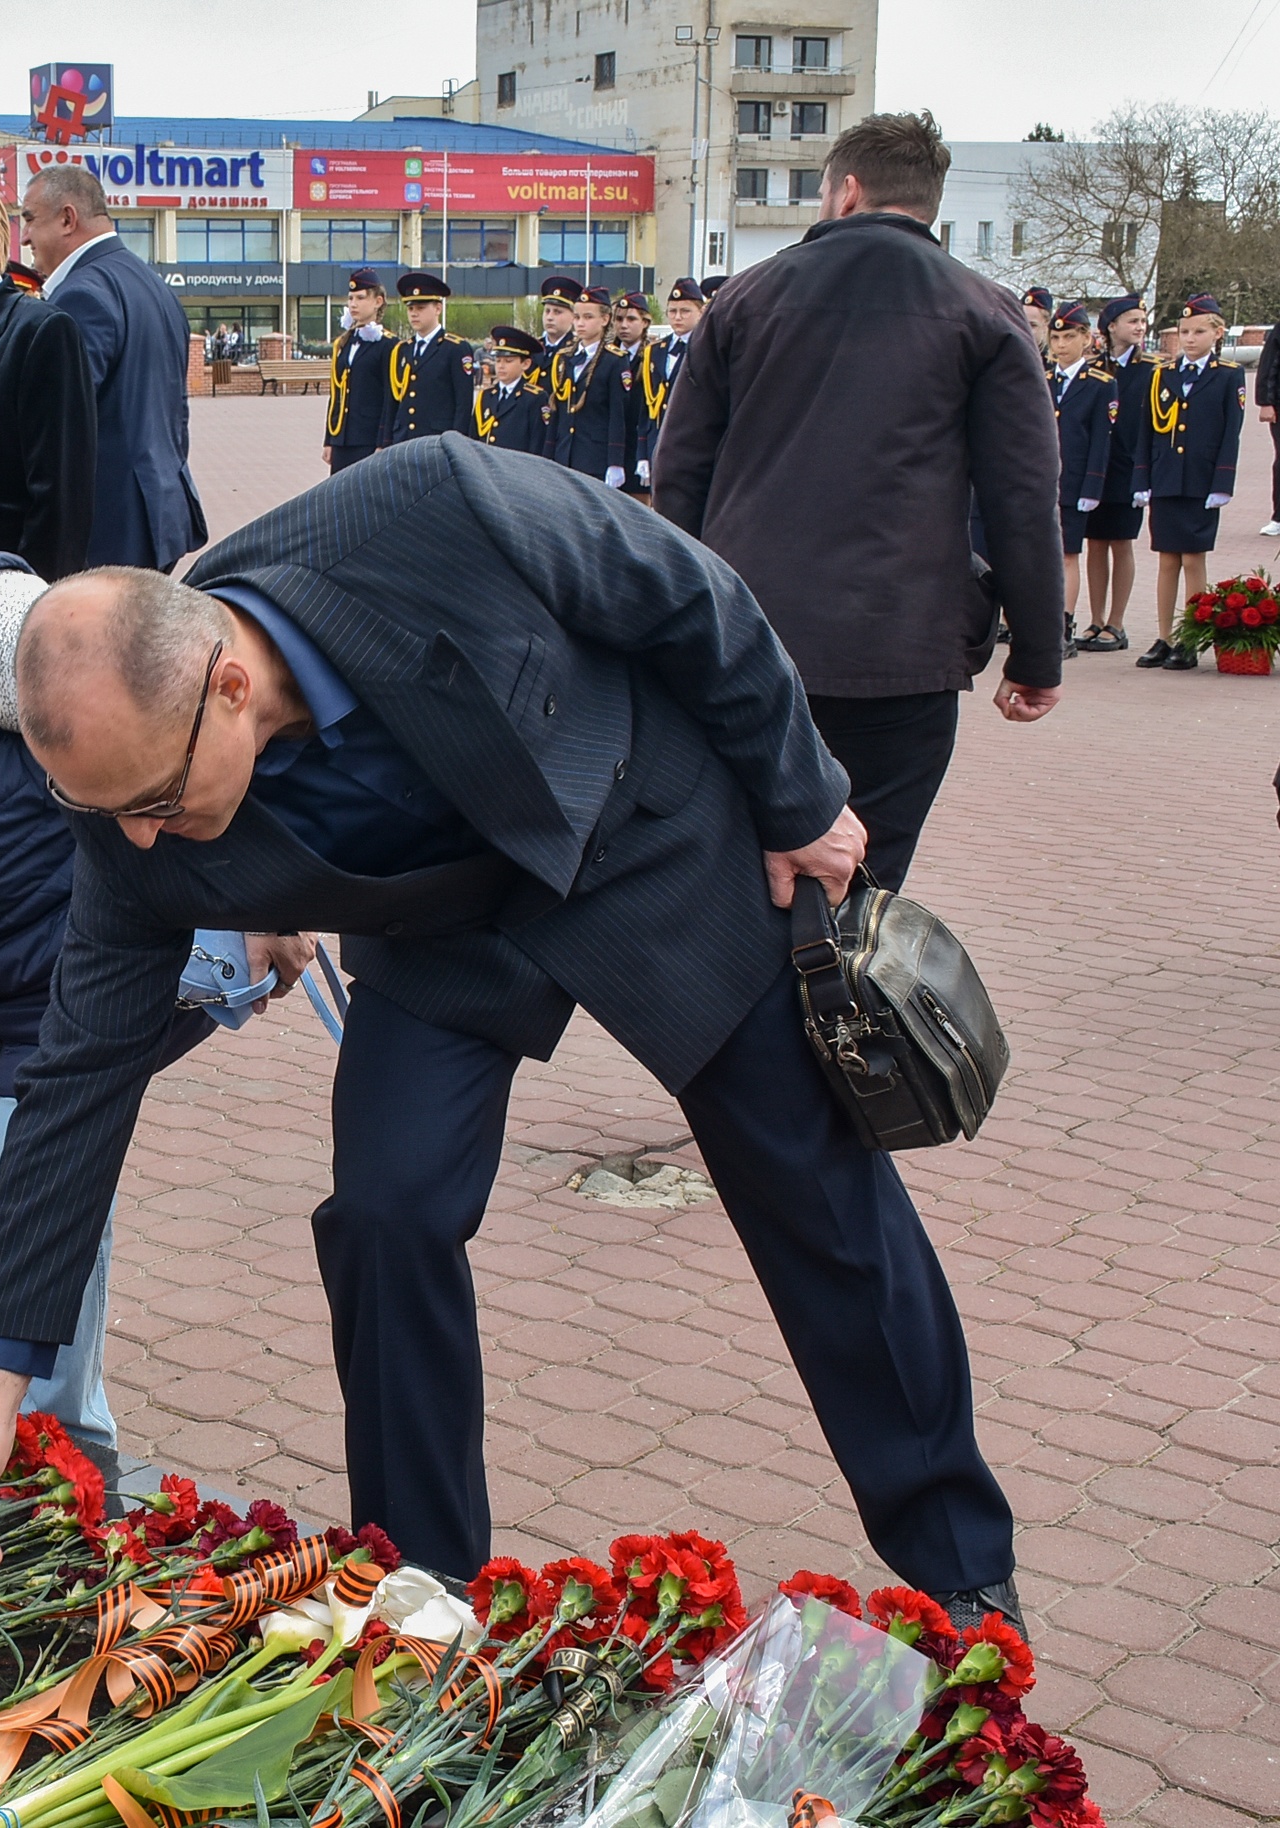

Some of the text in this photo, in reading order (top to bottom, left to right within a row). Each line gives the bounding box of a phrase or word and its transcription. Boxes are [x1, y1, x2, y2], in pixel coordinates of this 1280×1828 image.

[86, 143, 265, 188] voltmart
[502, 167, 534, 176] Больше
[535, 168, 568, 178] товаров
[629, 170, 639, 178] на
[507, 182, 628, 200] voltmart.su
[188, 196, 268, 208] домашняя
[187, 273, 242, 287] продукты
[245, 275, 253, 286] у
[255, 274, 284, 286] дома
